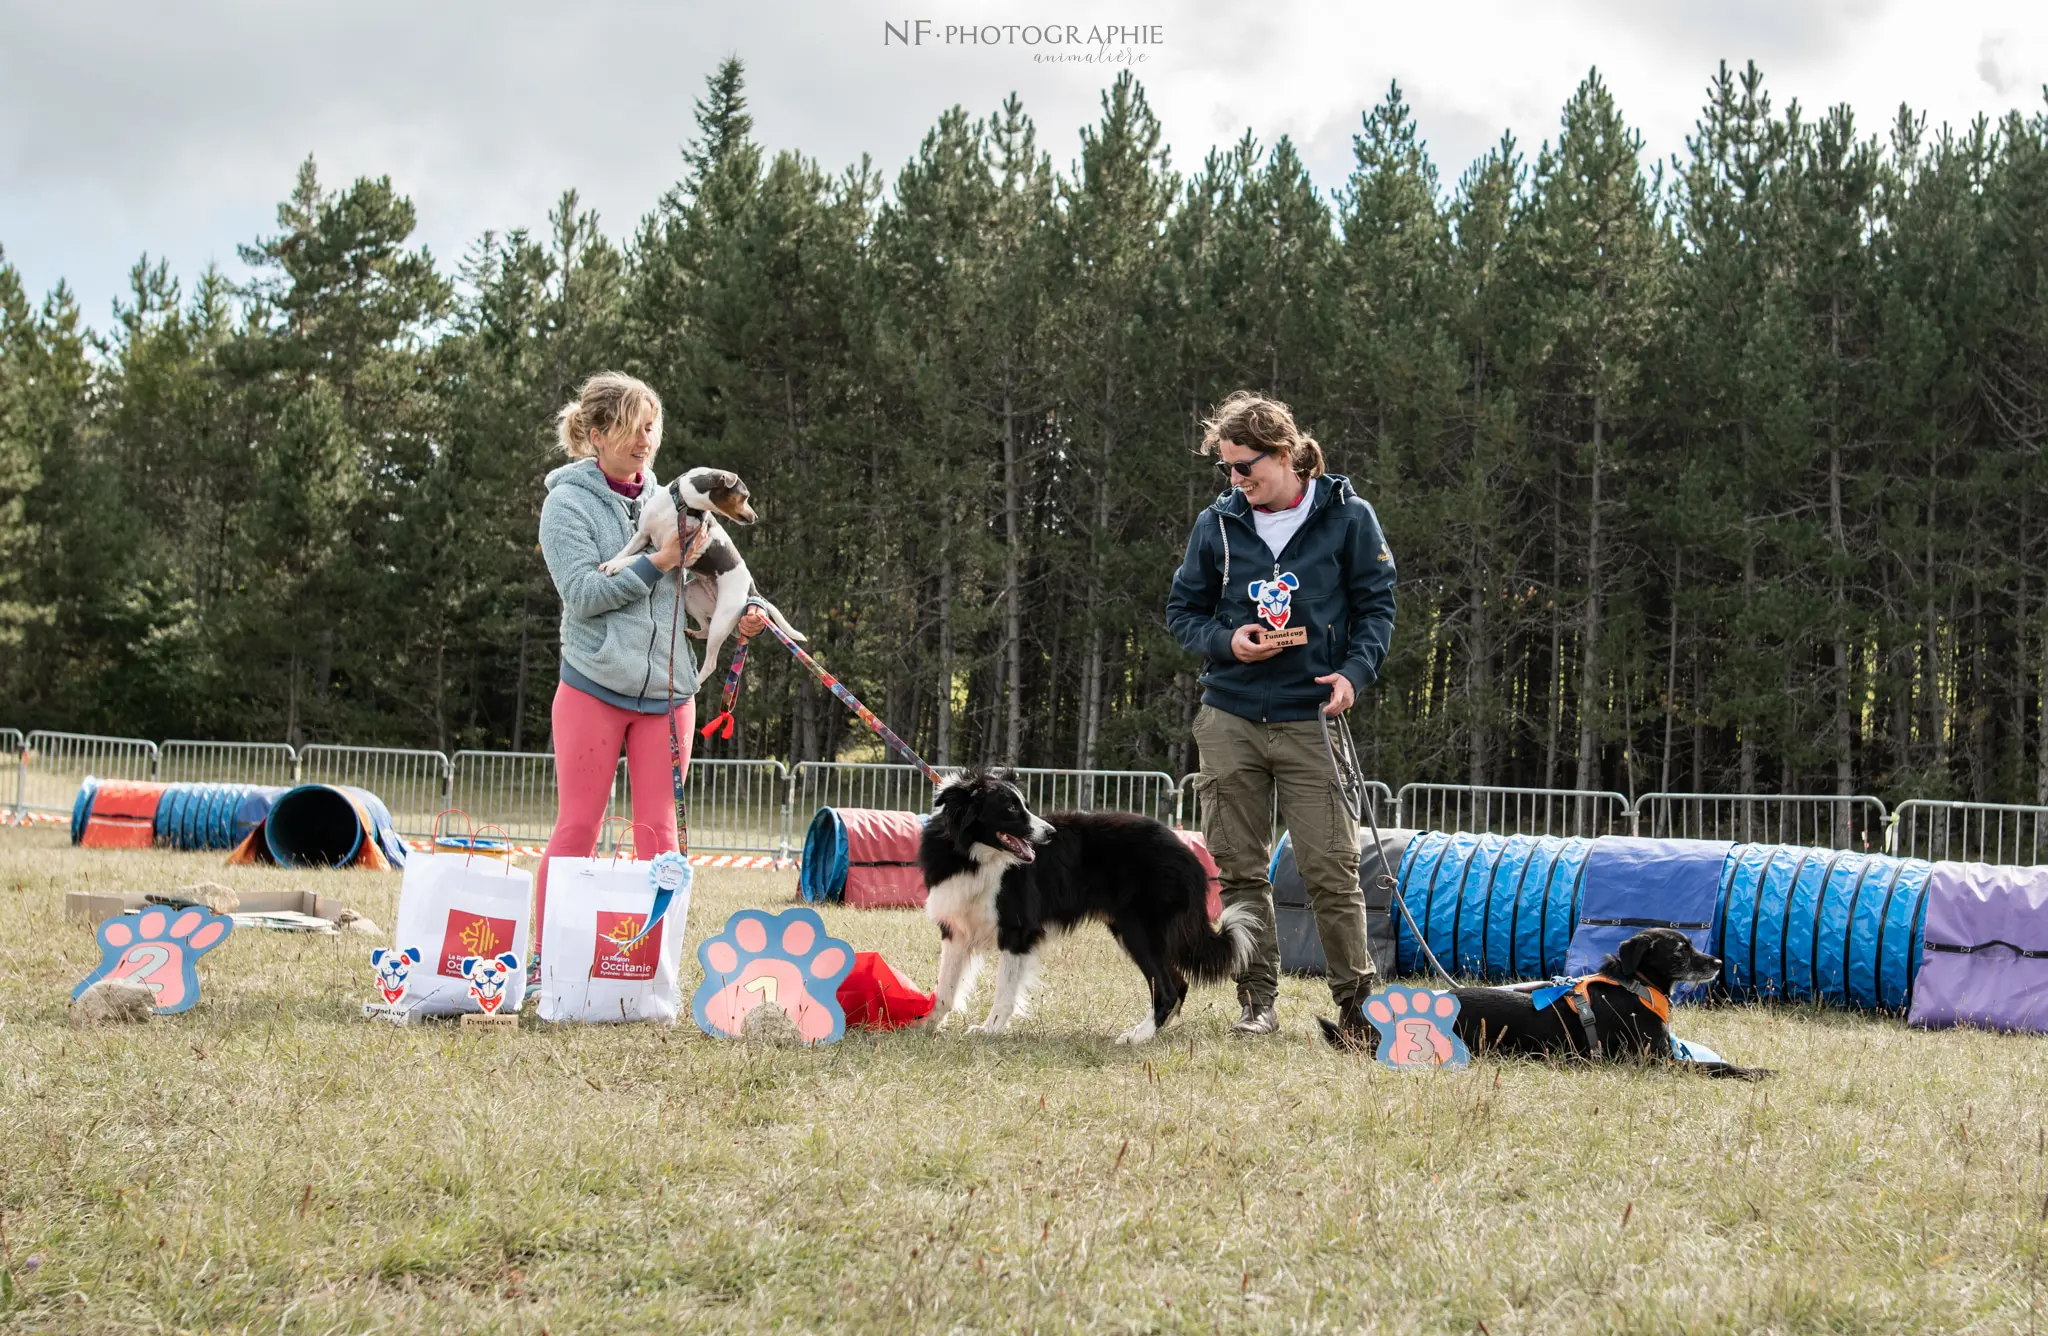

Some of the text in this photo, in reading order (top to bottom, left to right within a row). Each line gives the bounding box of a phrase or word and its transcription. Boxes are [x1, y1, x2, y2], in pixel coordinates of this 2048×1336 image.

[1264, 632, 1290, 640] Tunnel
[128, 945, 170, 993] 2
[600, 961, 651, 973] Occitanie
[1404, 1023, 1435, 1062] 3
